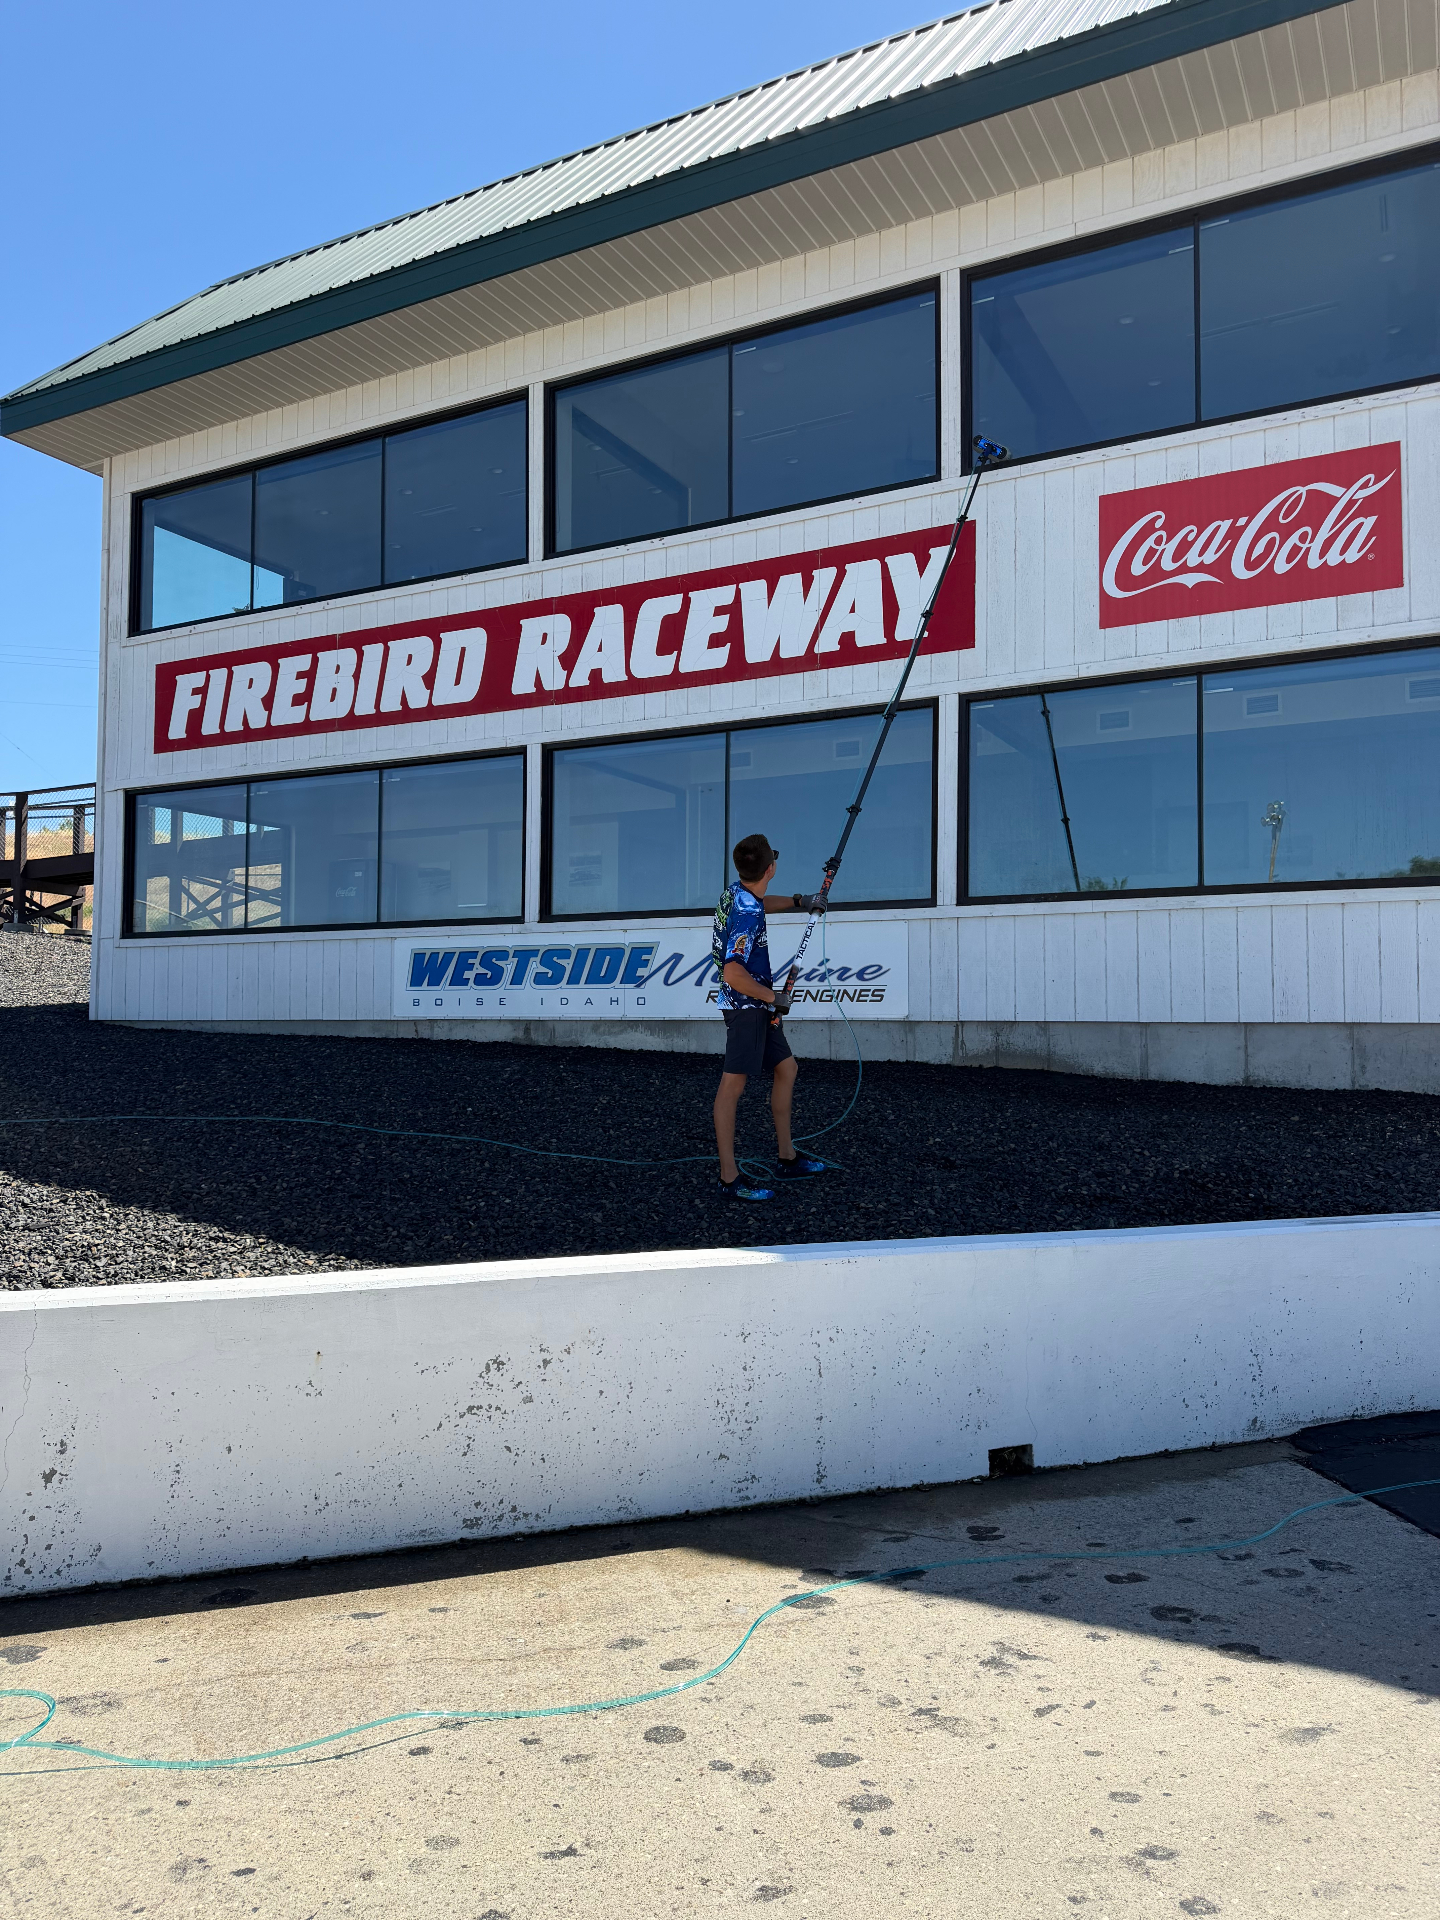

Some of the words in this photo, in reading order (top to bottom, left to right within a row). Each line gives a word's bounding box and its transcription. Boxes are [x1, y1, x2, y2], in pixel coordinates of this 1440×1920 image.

[1103, 469, 1397, 599] Coca-Cola
[169, 627, 488, 740] FIREBIRD
[511, 545, 957, 696] RACEWAY
[796, 920, 816, 960] TACTICAL
[407, 943, 658, 990] WESTSIDE
[633, 952, 892, 988] Mhine
[412, 997, 507, 1007] BOISE
[540, 996, 647, 1006] IDAHO
[791, 988, 887, 1004] ENGINES
